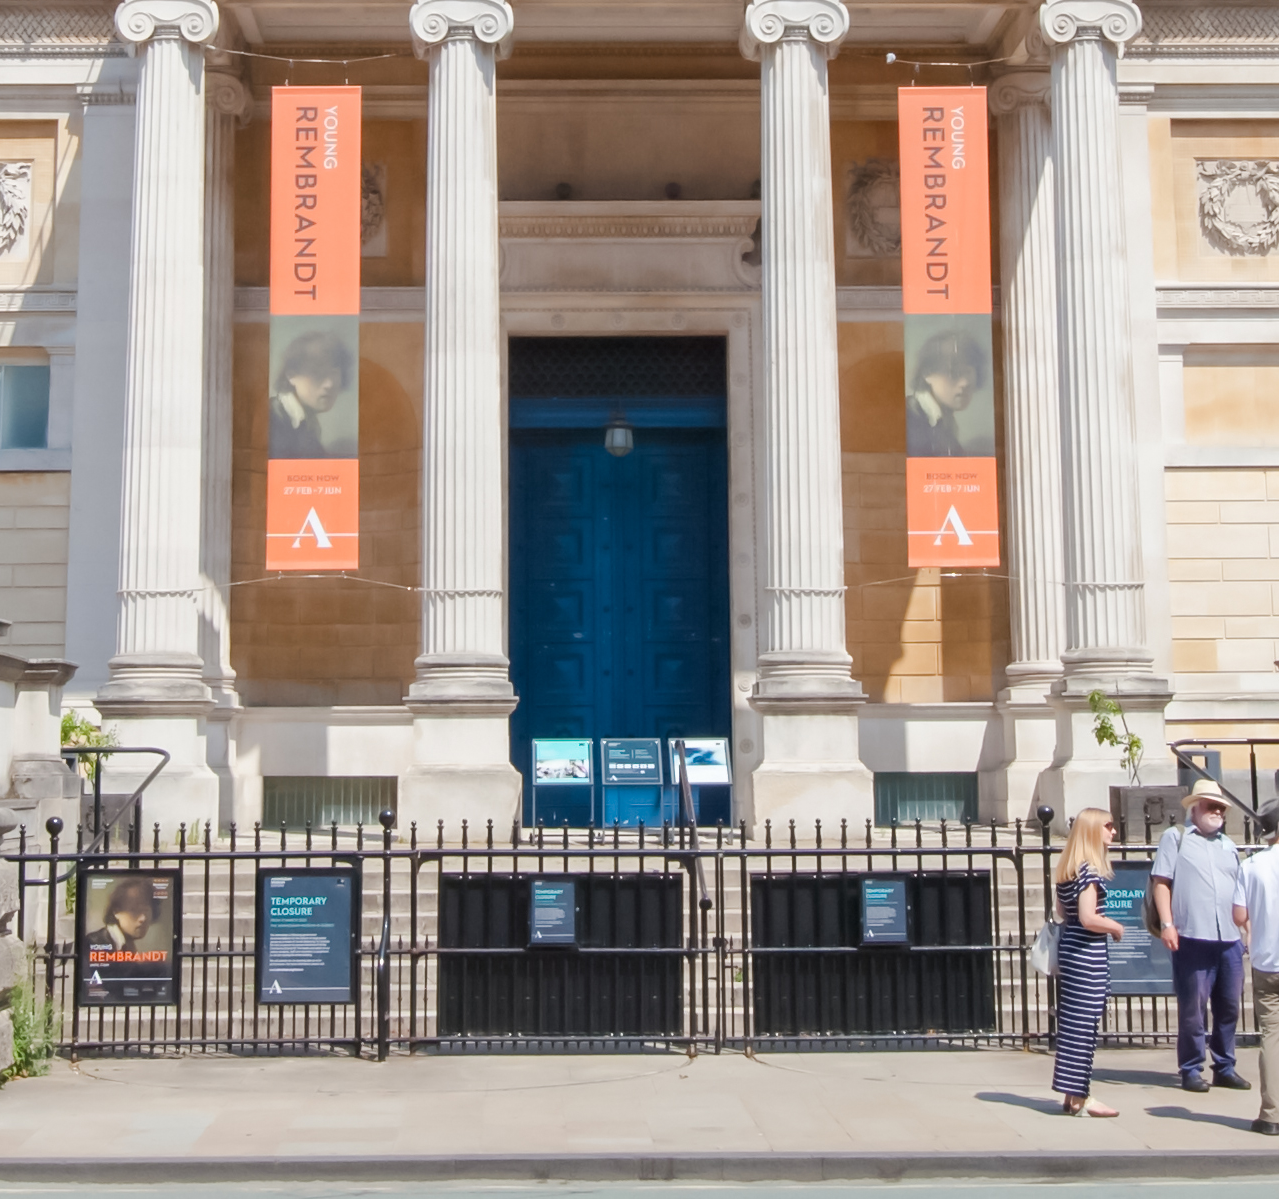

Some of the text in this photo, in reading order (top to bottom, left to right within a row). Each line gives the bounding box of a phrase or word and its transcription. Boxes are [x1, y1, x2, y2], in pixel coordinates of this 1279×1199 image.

[323, 105, 338, 170] YOUNG
[950, 105, 966, 170] YOUNG
[294, 106, 318, 301] REMBRANDT
[922, 106, 949, 300] REMBRANDT
[287, 474, 339, 482] BOOK NOW
[926, 472, 978, 480] BOOK NOW
[283, 486, 294, 495] 27
[296, 486, 312, 495] FEB
[325, 486, 342, 495] JUN
[923, 485, 934, 493] 27
[936, 484, 952, 493] FEB
[291, 506, 333, 549] A
[933, 504, 974, 546] A
[270, 897, 327, 906] TEMPORARY
[270, 907, 313, 916] CLOSURE
[89, 951, 168, 962] REMBRANDT
